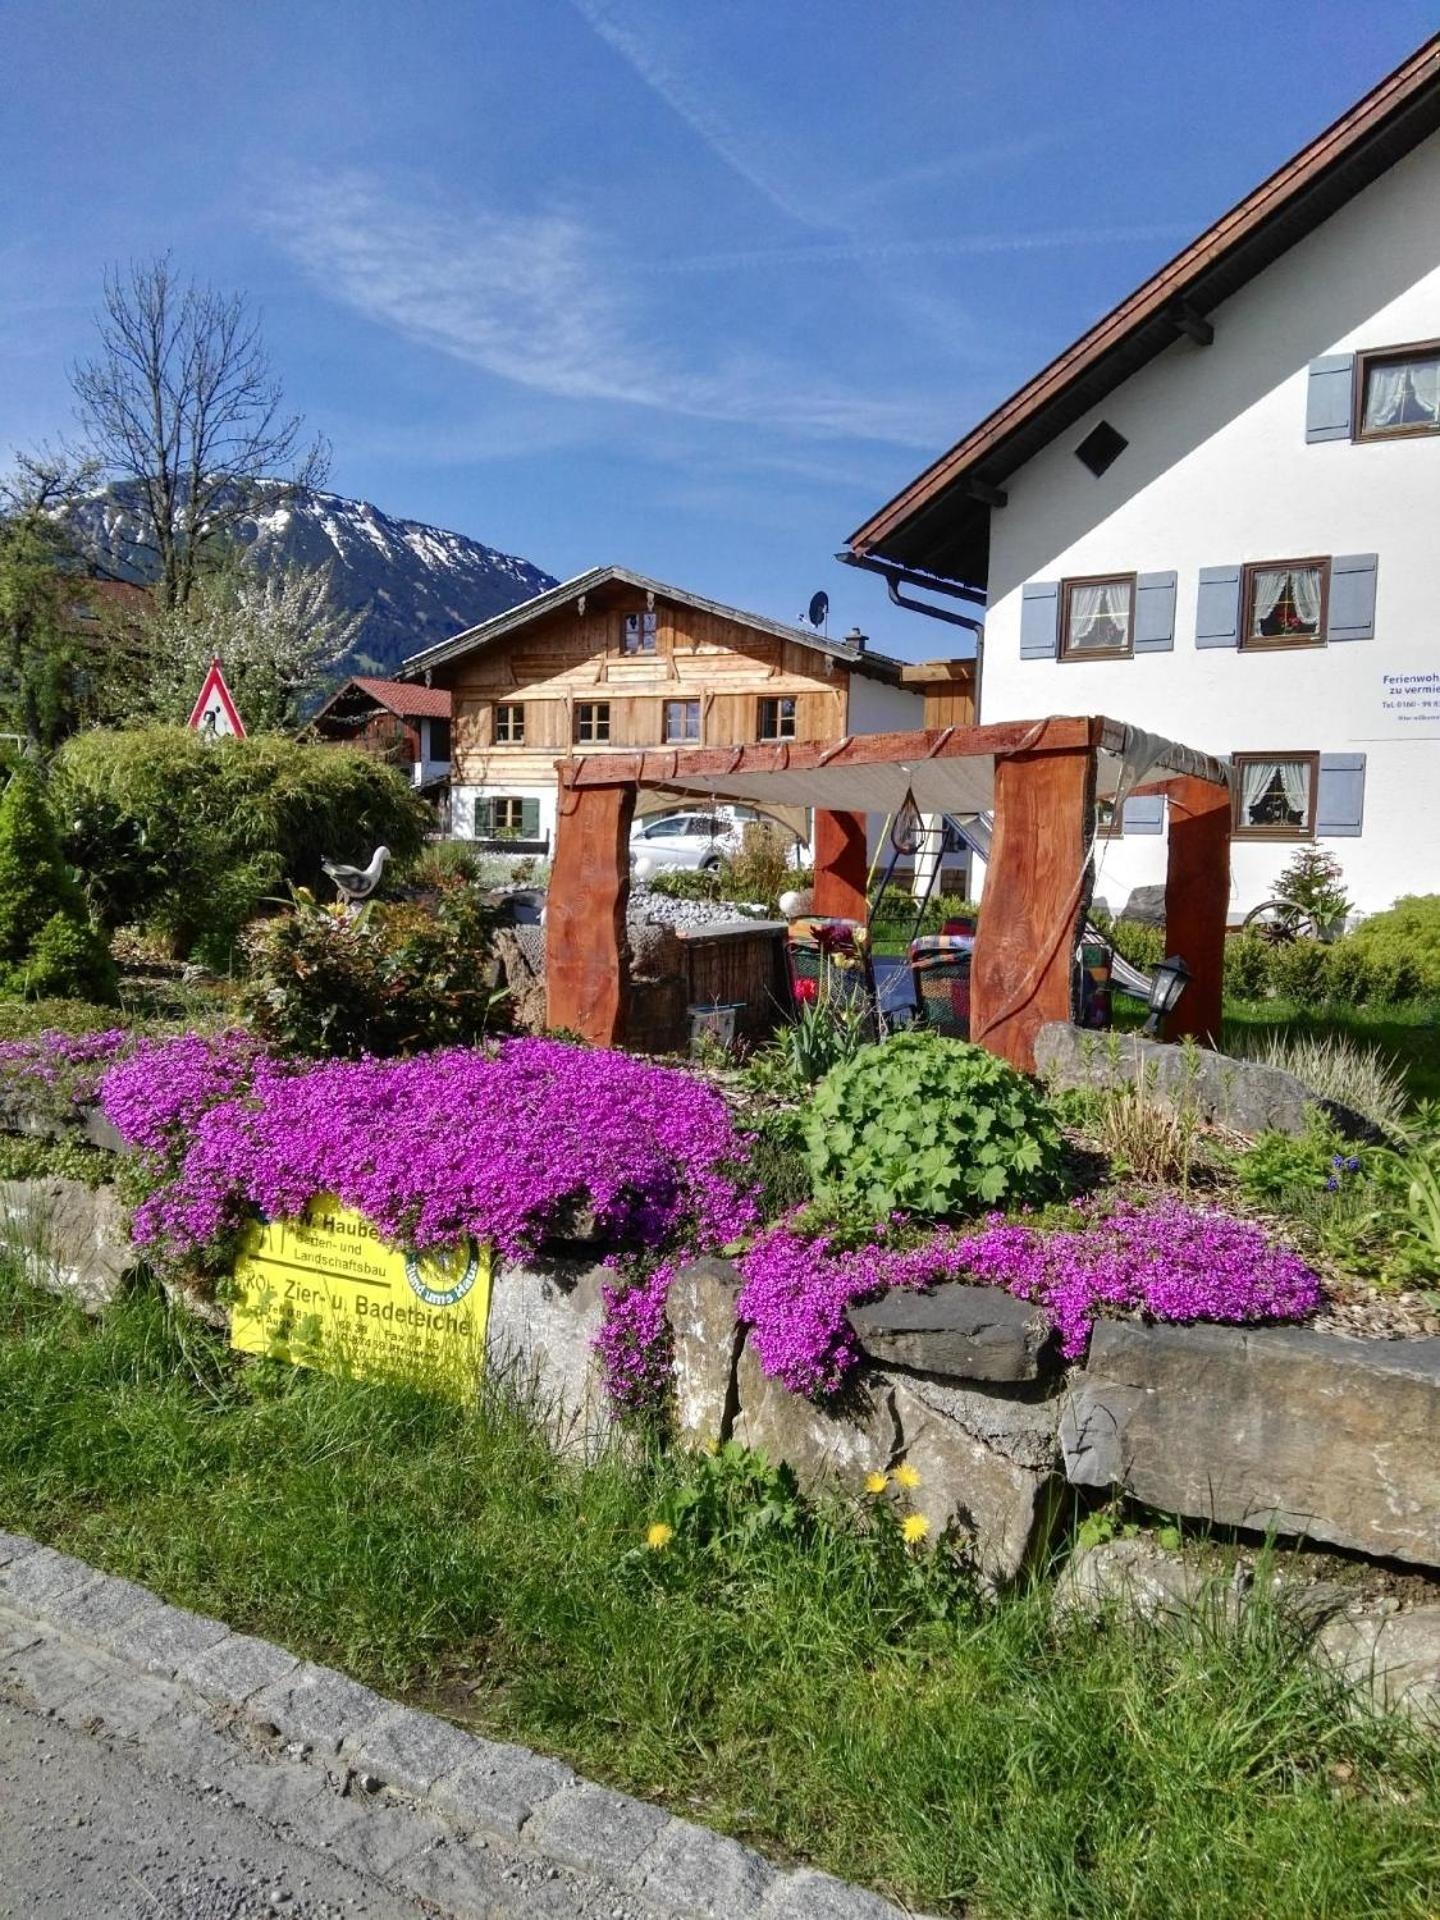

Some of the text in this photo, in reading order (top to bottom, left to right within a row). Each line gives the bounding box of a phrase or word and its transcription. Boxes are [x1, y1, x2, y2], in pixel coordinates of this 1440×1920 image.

[322, 1213, 380, 1241] Haube
[294, 1248, 386, 1277] Landschaftsbau
[340, 1243, 363, 1256] und
[455, 1260, 478, 1298] Haus
[284, 1278, 326, 1304] Zier-
[331, 1294, 348, 1312] u.
[355, 1295, 471, 1337] Badeteiche
